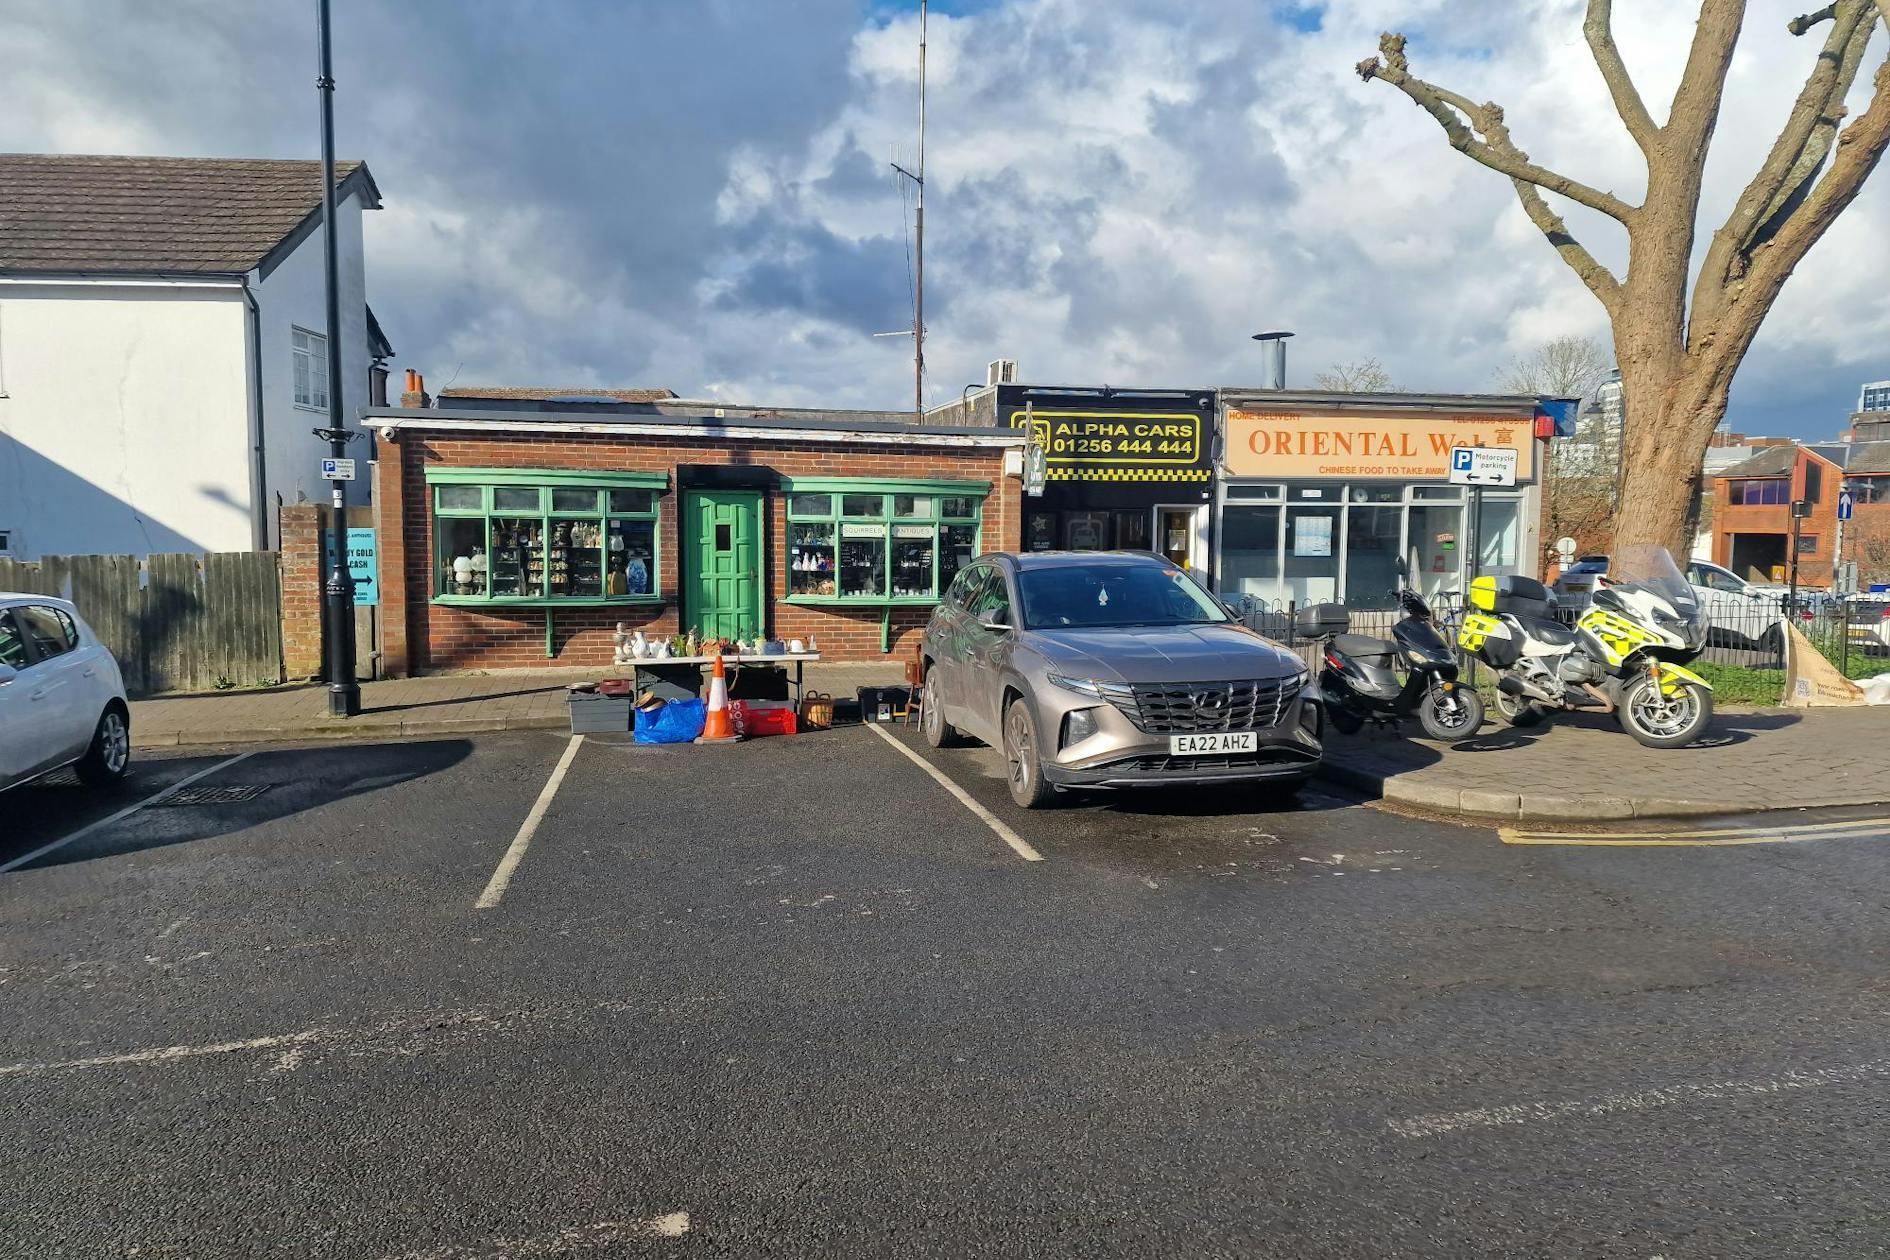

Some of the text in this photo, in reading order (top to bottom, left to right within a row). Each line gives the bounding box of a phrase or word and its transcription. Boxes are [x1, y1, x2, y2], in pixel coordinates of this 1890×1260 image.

[1229, 411, 1301, 421] HOME DELIVERY
[1056, 423, 1193, 437] ALPHA CARS
[1053, 438, 1193, 454] 01256 444 444
[1249, 430, 1417, 457] ORIENTAL
[1458, 451, 1471, 469] P
[1475, 453, 1515, 462] Motorcycle
[1318, 466, 1447, 475] CHINESE FOOD TO TAKE AWAY
[1481, 462, 1508, 470] parking
[356, 549, 373, 557] GOLD
[350, 560, 368, 569] CASH
[1178, 735, 1250, 752] EA22 AHZ
